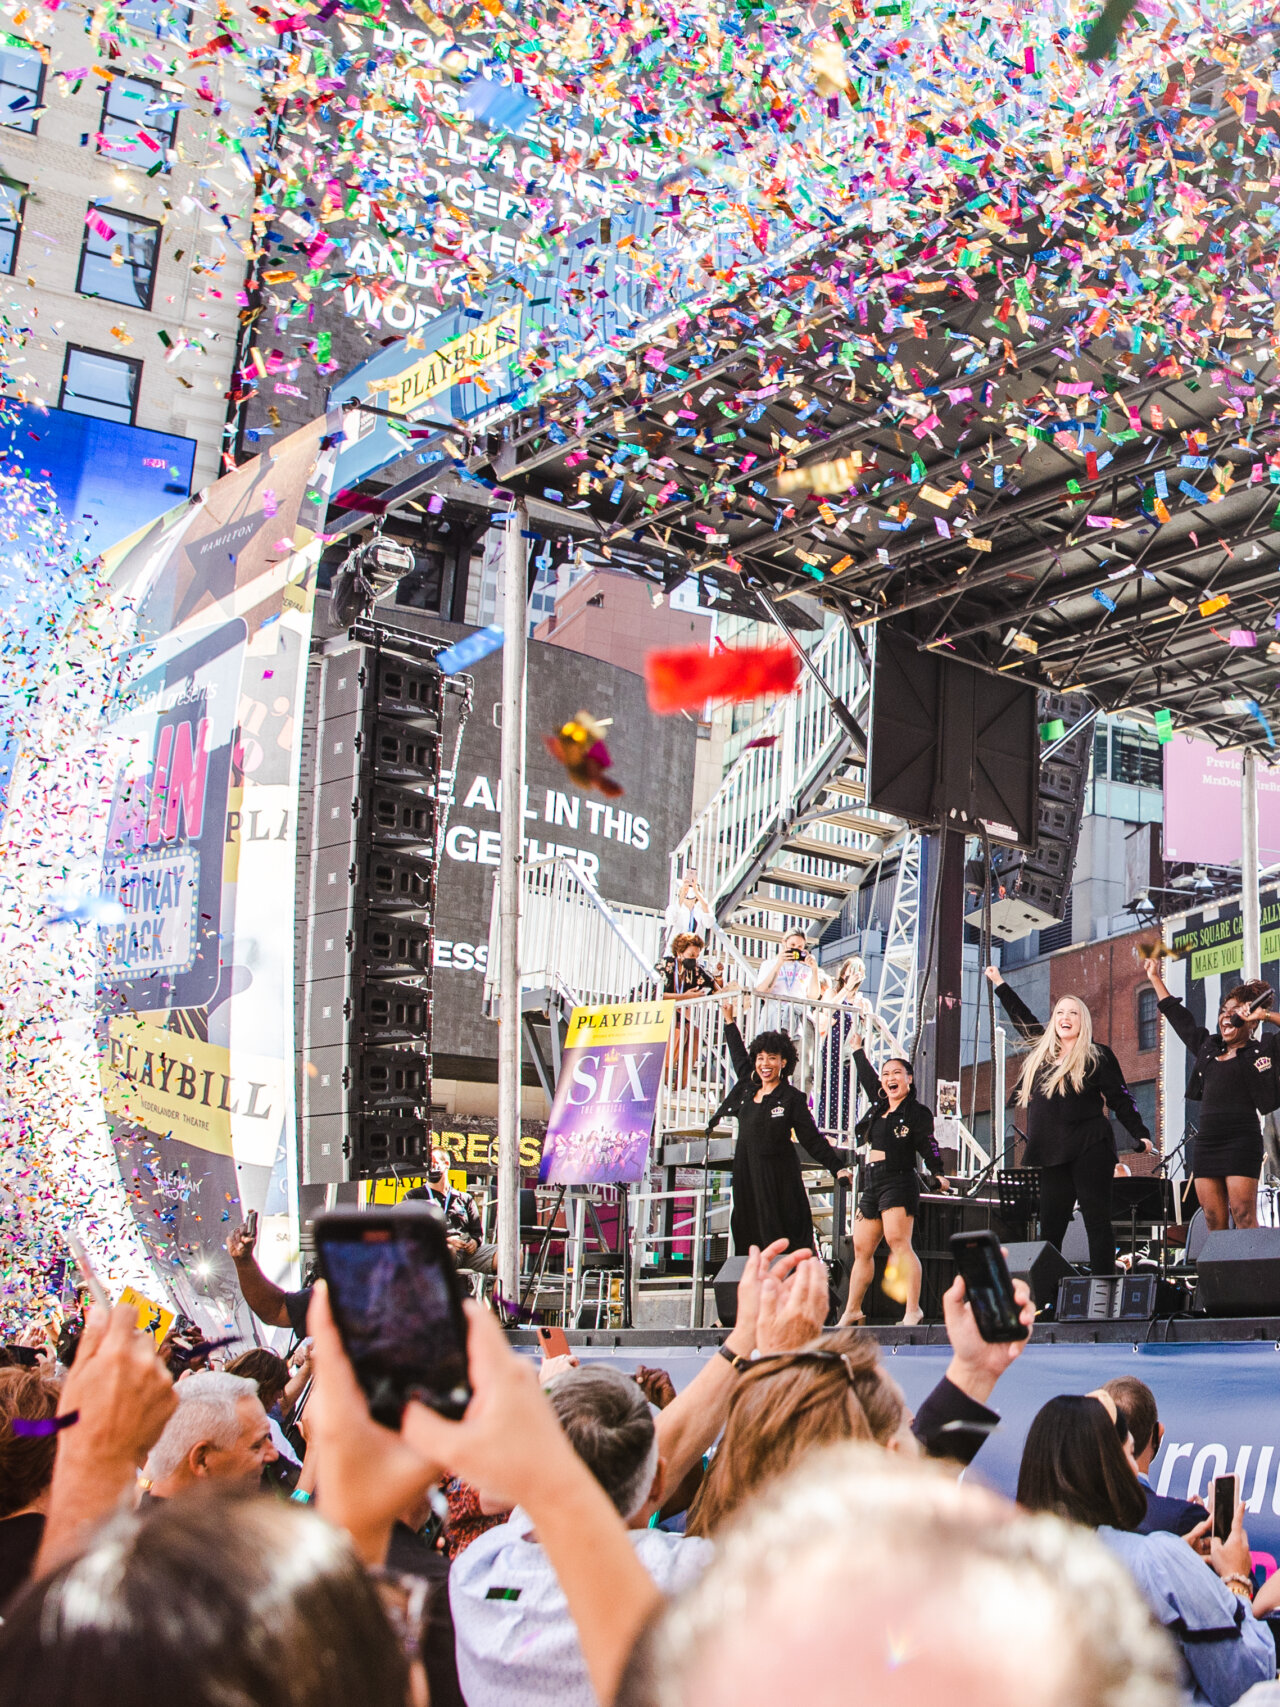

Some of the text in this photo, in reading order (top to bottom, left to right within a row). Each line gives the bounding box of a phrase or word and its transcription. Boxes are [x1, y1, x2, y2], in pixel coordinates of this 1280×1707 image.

[345, 238, 437, 288] AND
[200, 523, 254, 555] HAMILTON
[462, 775, 538, 820] AL
[545, 789, 580, 829] IN
[585, 800, 650, 850] THIS
[115, 917, 165, 965] BACK
[1200, 920, 1231, 947] SQUARE
[1194, 951, 1219, 974] MAKE
[1221, 945, 1238, 967] YOU
[575, 1010, 665, 1030] PLAYBILL
[108, 1037, 272, 1120] PLAYBILL
[565, 1050, 654, 1107] SIX
[140, 1100, 210, 1132] NEDERLANDER THEATRE
